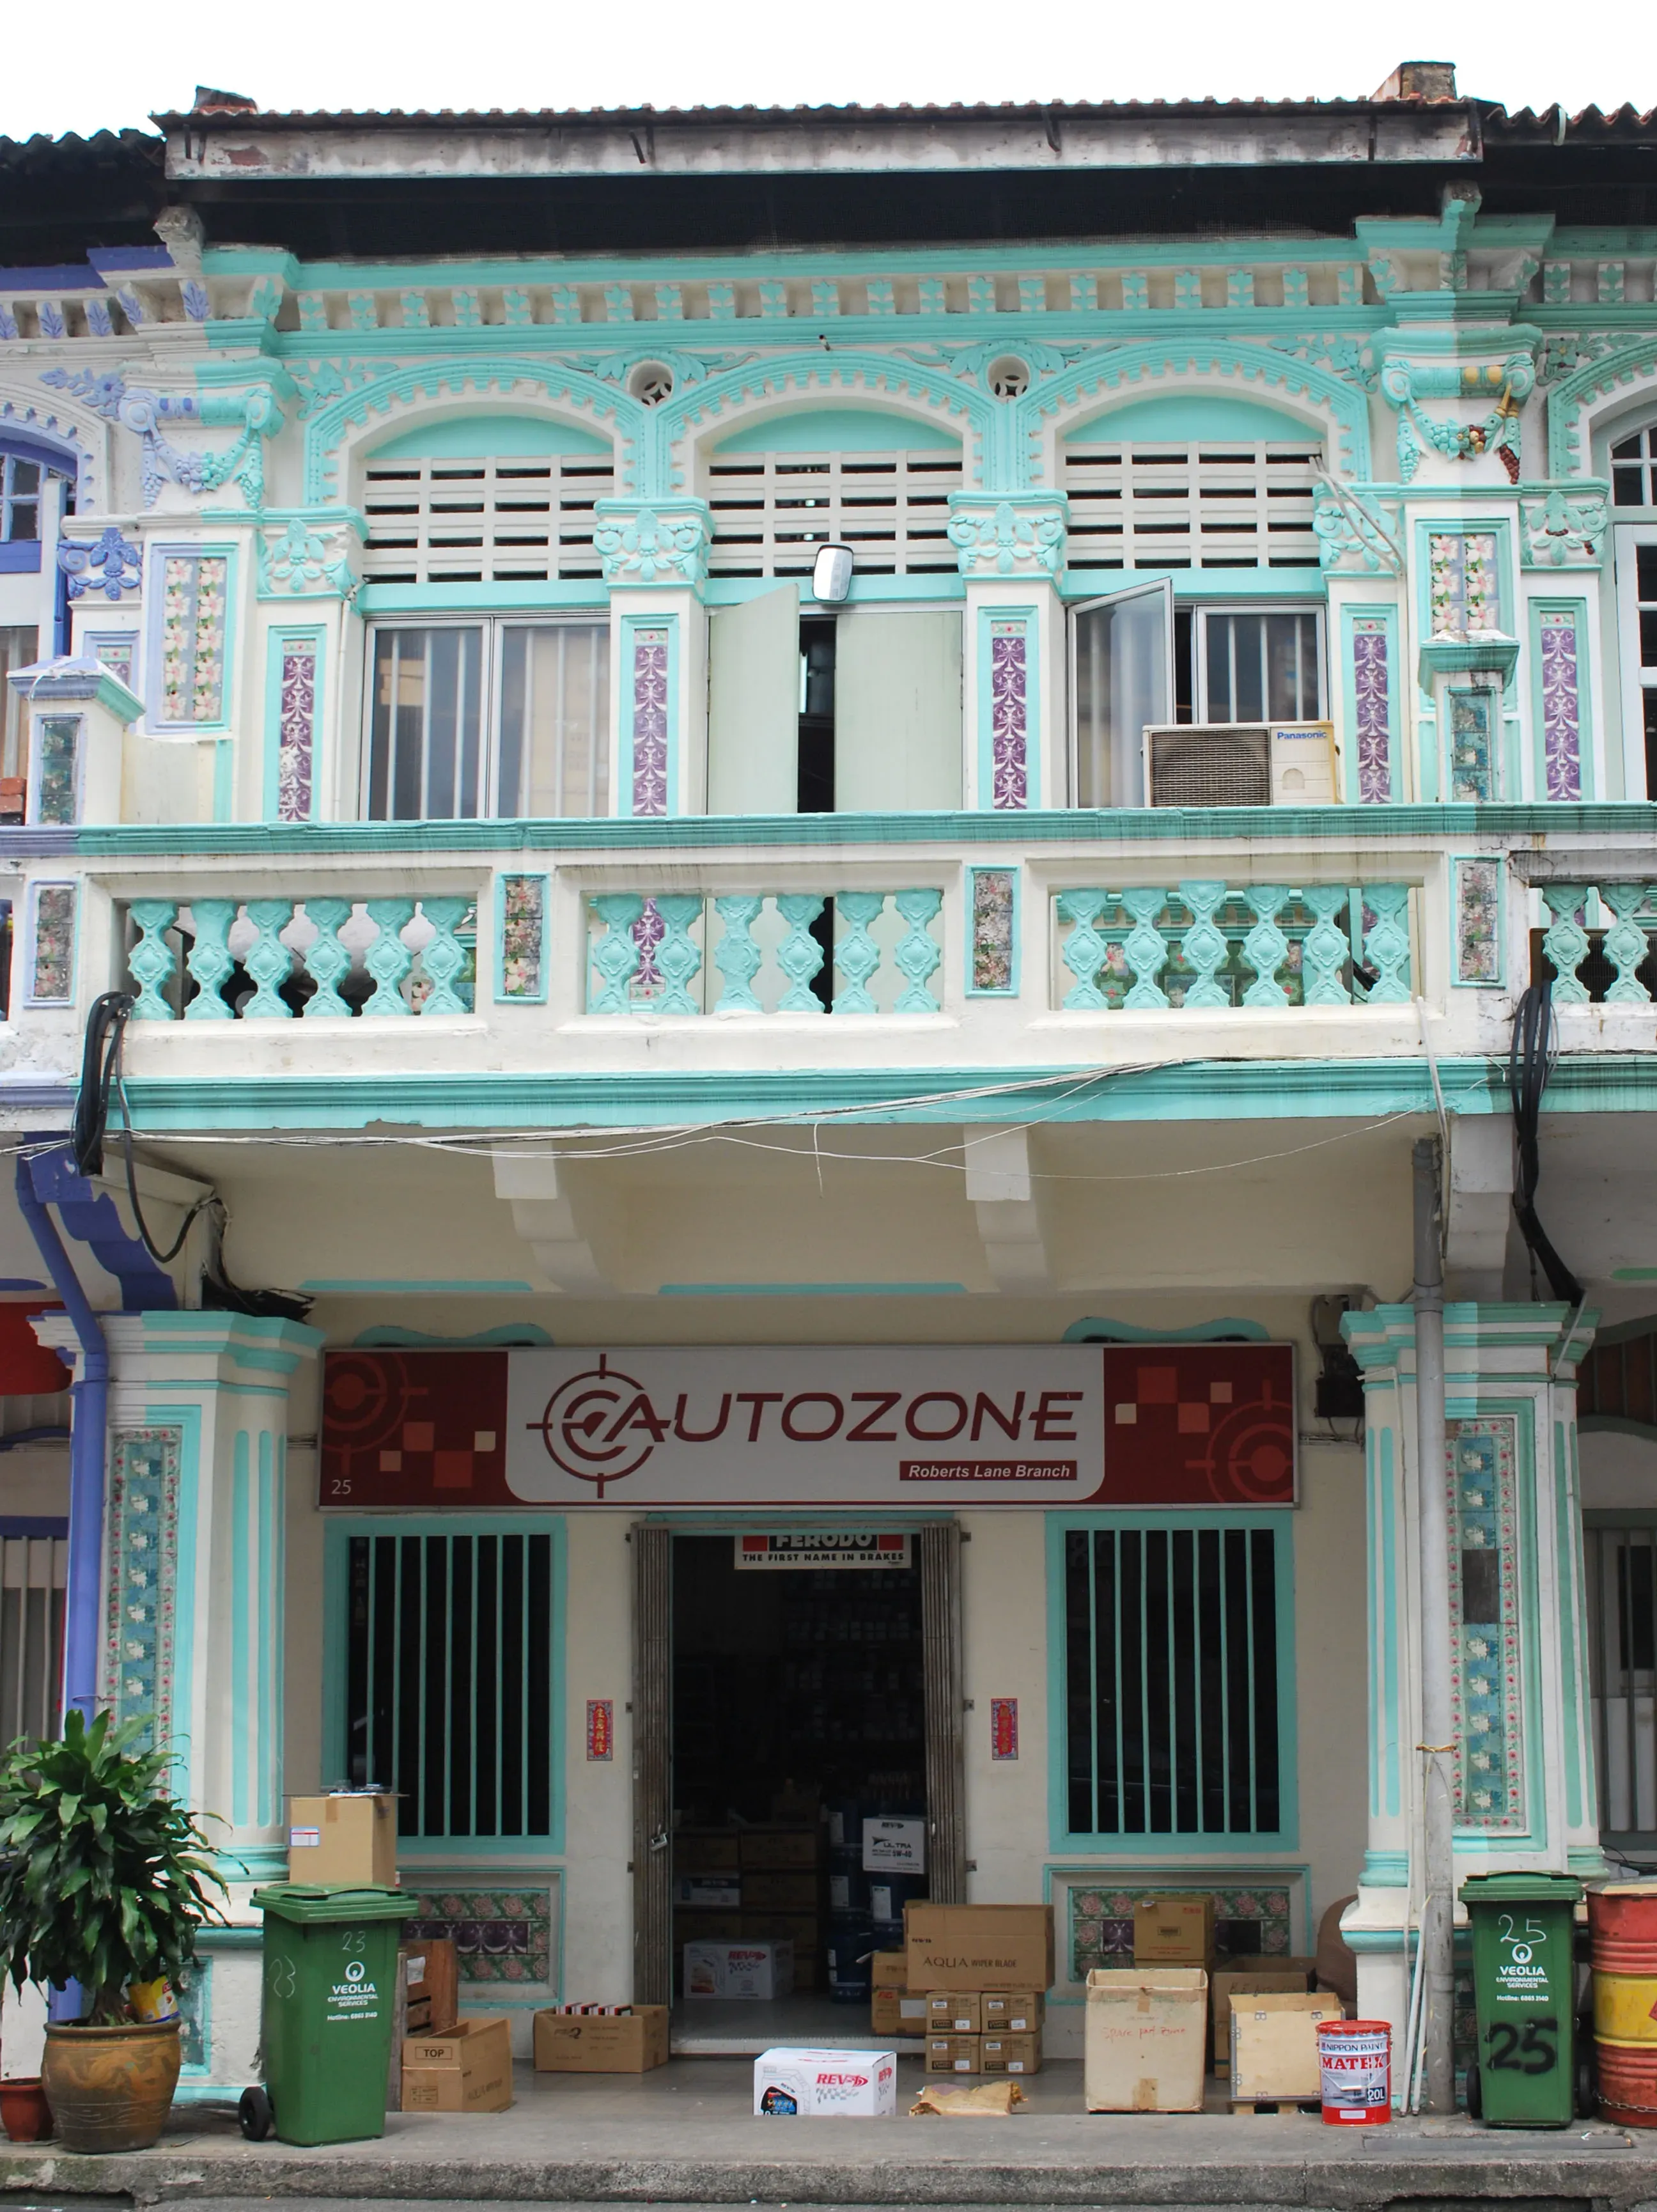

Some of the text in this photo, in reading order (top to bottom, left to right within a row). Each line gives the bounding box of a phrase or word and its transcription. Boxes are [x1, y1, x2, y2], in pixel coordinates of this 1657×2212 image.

[1277, 730, 1327, 739] Panasonic
[602, 1391, 1084, 1442] AUTOZONE
[908, 1465, 1070, 1477] Roberts Lane Branch
[331, 1479, 352, 1495] 25
[775, 1534, 873, 1548] FERODO
[743, 1554, 763, 1562] THE
[804, 1553, 837, 1561] NAME
[842, 1553, 855, 1561] IN
[1498, 1914, 1546, 1944] 25
[342, 1931, 366, 1952] 23
[923, 1957, 1017, 1968] AQUA WIPER BLADE
[1499, 1966, 1546, 1975] VEOLIA
[332, 1983, 376, 1995] VEOLIA
[327, 1994, 378, 2002] ENVIRONMENTAL
[1326, 2042, 1384, 2052] NIPPON PAINT
[1484, 2017, 1559, 2075] 25
[424, 2048, 445, 2058] TOP
[1322, 2055, 1384, 2070] MATEX
[1367, 2088, 1385, 2101] 20L
